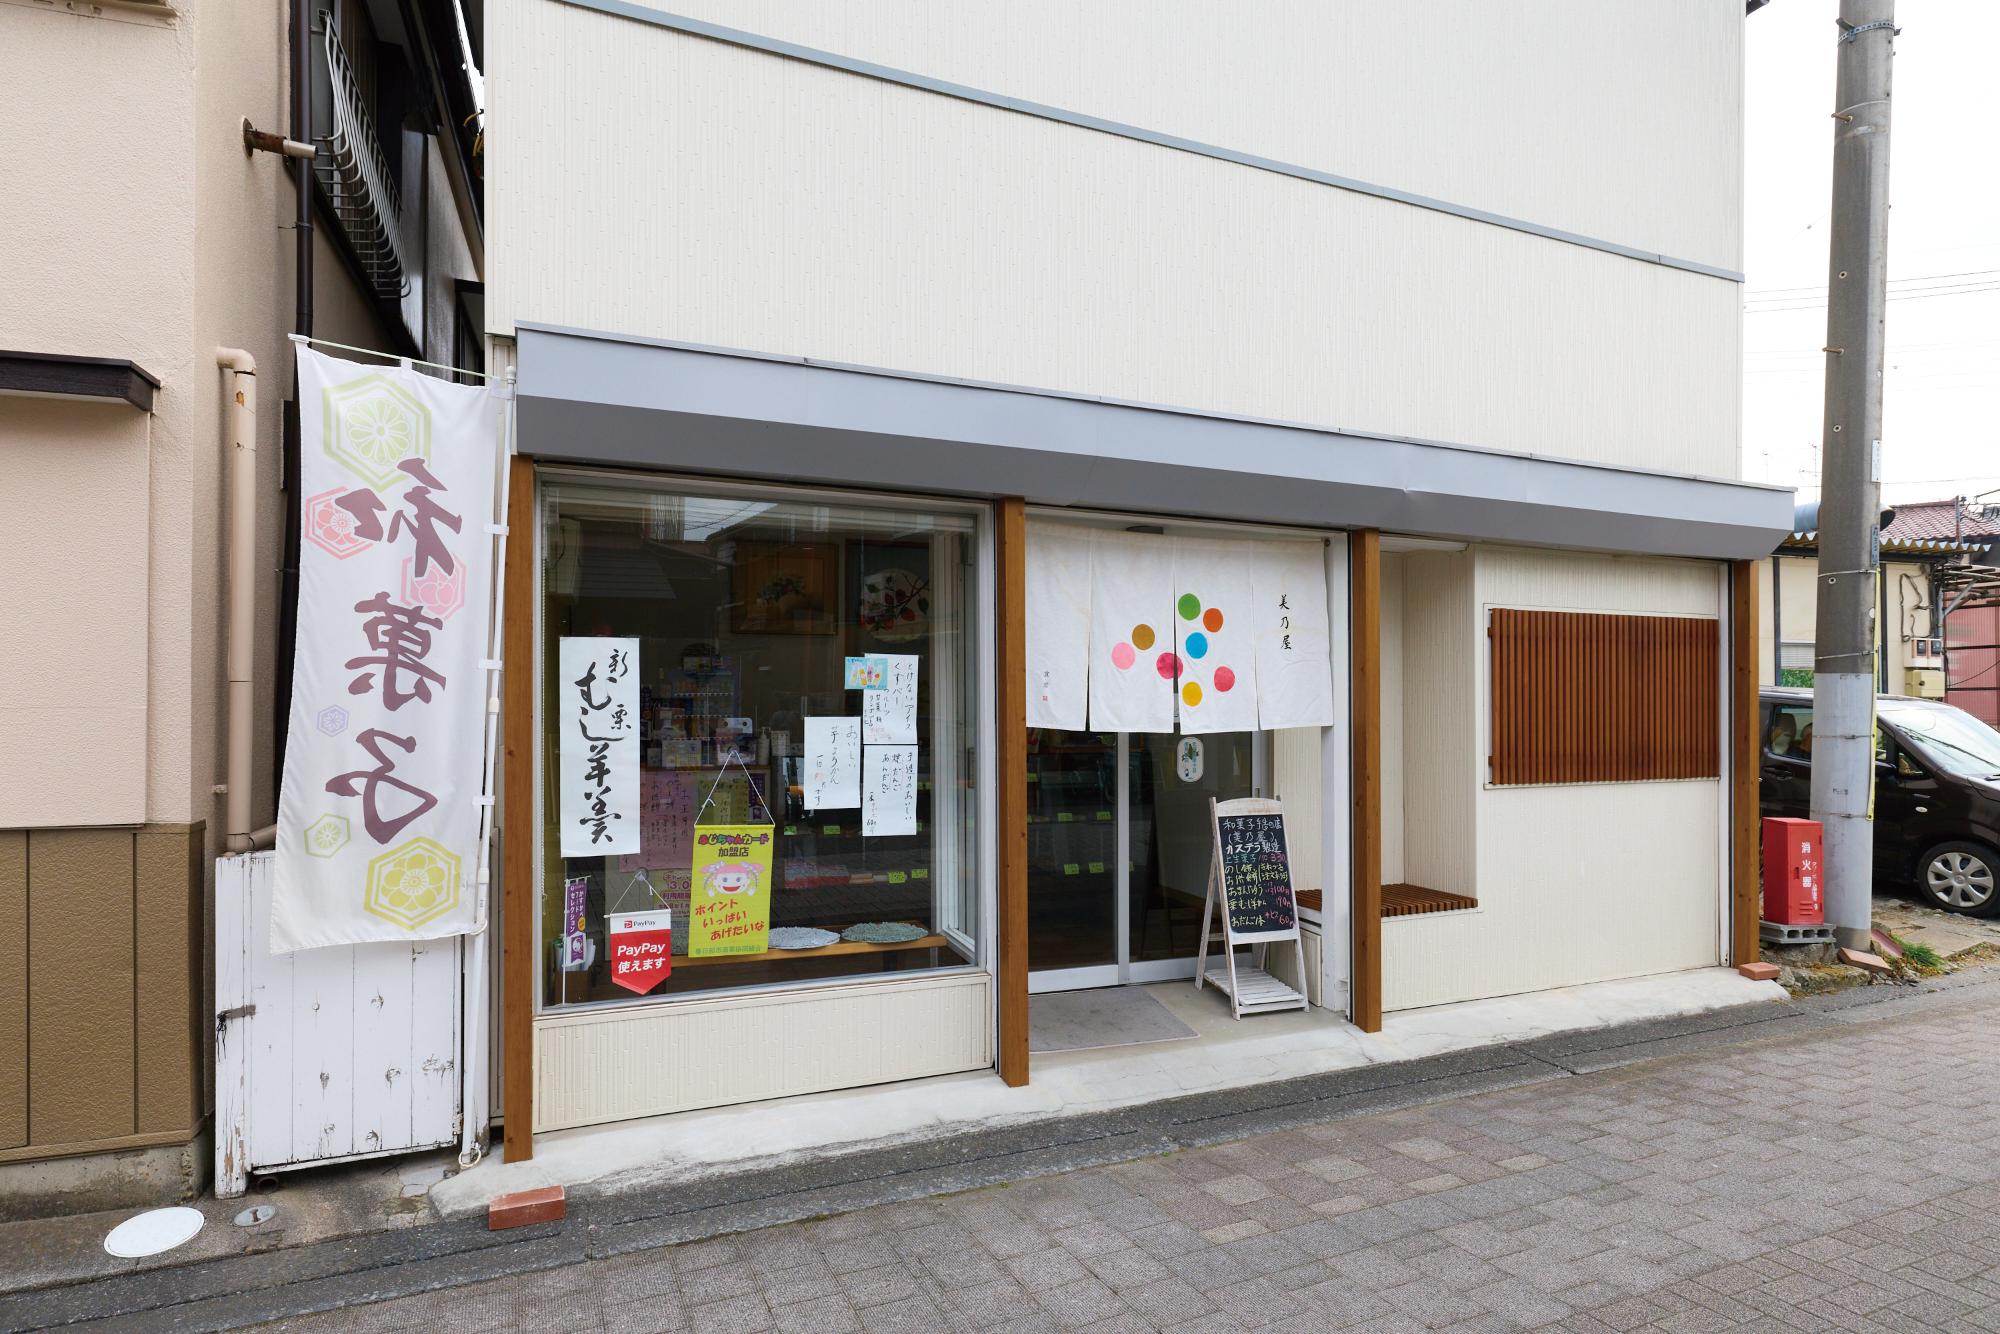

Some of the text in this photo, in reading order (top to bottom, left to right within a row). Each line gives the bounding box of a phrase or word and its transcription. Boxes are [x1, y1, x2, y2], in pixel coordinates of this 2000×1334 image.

[1279, 594, 1292, 650] 美乃屋
[718, 846, 750, 858] 加盟店
[1801, 841, 1812, 888] 消火器
[695, 898, 738, 917] ポイント
[633, 919, 657, 929] PayPay
[703, 911, 747, 928] いっぱい
[711, 920, 765, 941] あげたいな
[617, 942, 666, 957] PayPay
[618, 956, 666, 975] 使えます
